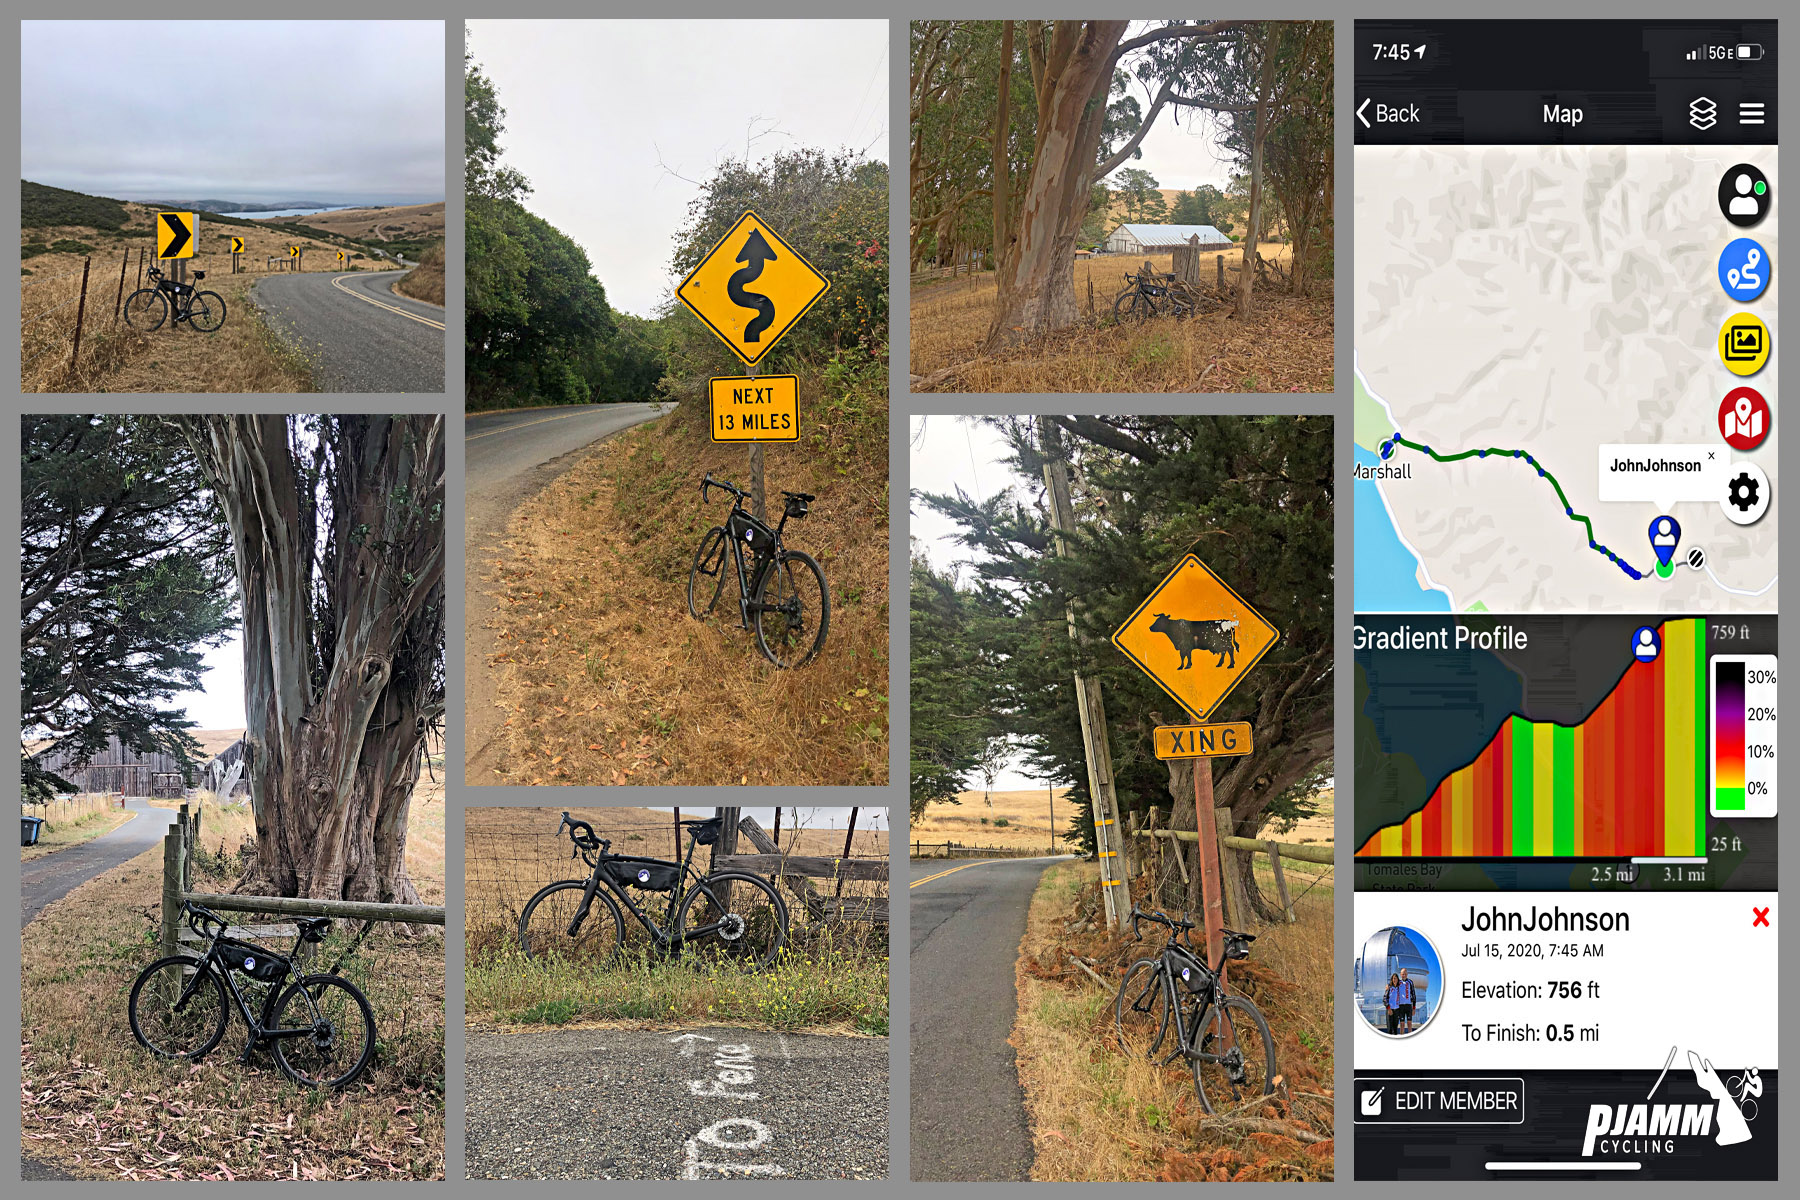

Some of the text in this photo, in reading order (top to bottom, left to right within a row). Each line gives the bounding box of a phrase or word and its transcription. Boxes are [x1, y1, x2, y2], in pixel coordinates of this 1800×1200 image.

[1373, 44, 1411, 60] 7:45
[1376, 104, 1420, 123] Back
[1543, 104, 1584, 127] Map
[733, 388, 774, 404] NEXT
[719, 413, 791, 430] 13 MILES
[1610, 459, 1702, 473] JohnJohnson
[1354, 626, 1528, 650] Gradient Profile
[1711, 625, 1750, 640] 759 ft
[1748, 670, 1777, 684] 30%
[1748, 707, 1777, 722] 20%
[1170, 728, 1236, 753] XING
[1748, 744, 1775, 759] 10%
[1748, 782, 1768, 796] 0%
[1711, 836, 1742, 852] 25 ft
[1421, 863, 1443, 879] Bay
[1591, 867, 1634, 882] 2.5 mi
[1663, 867, 1706, 882] 3.1 mi
[1461, 906, 1630, 932] JohnJohnson
[1461, 943, 1604, 960] Jul 15, 2020, 7:45 AM
[1462, 981, 1600, 999] Elevation: 756 ft
[1462, 1023, 1600, 1042] To Finish: 0.5 mi
[1396, 1092, 1518, 1110] EDIT MEMBER
